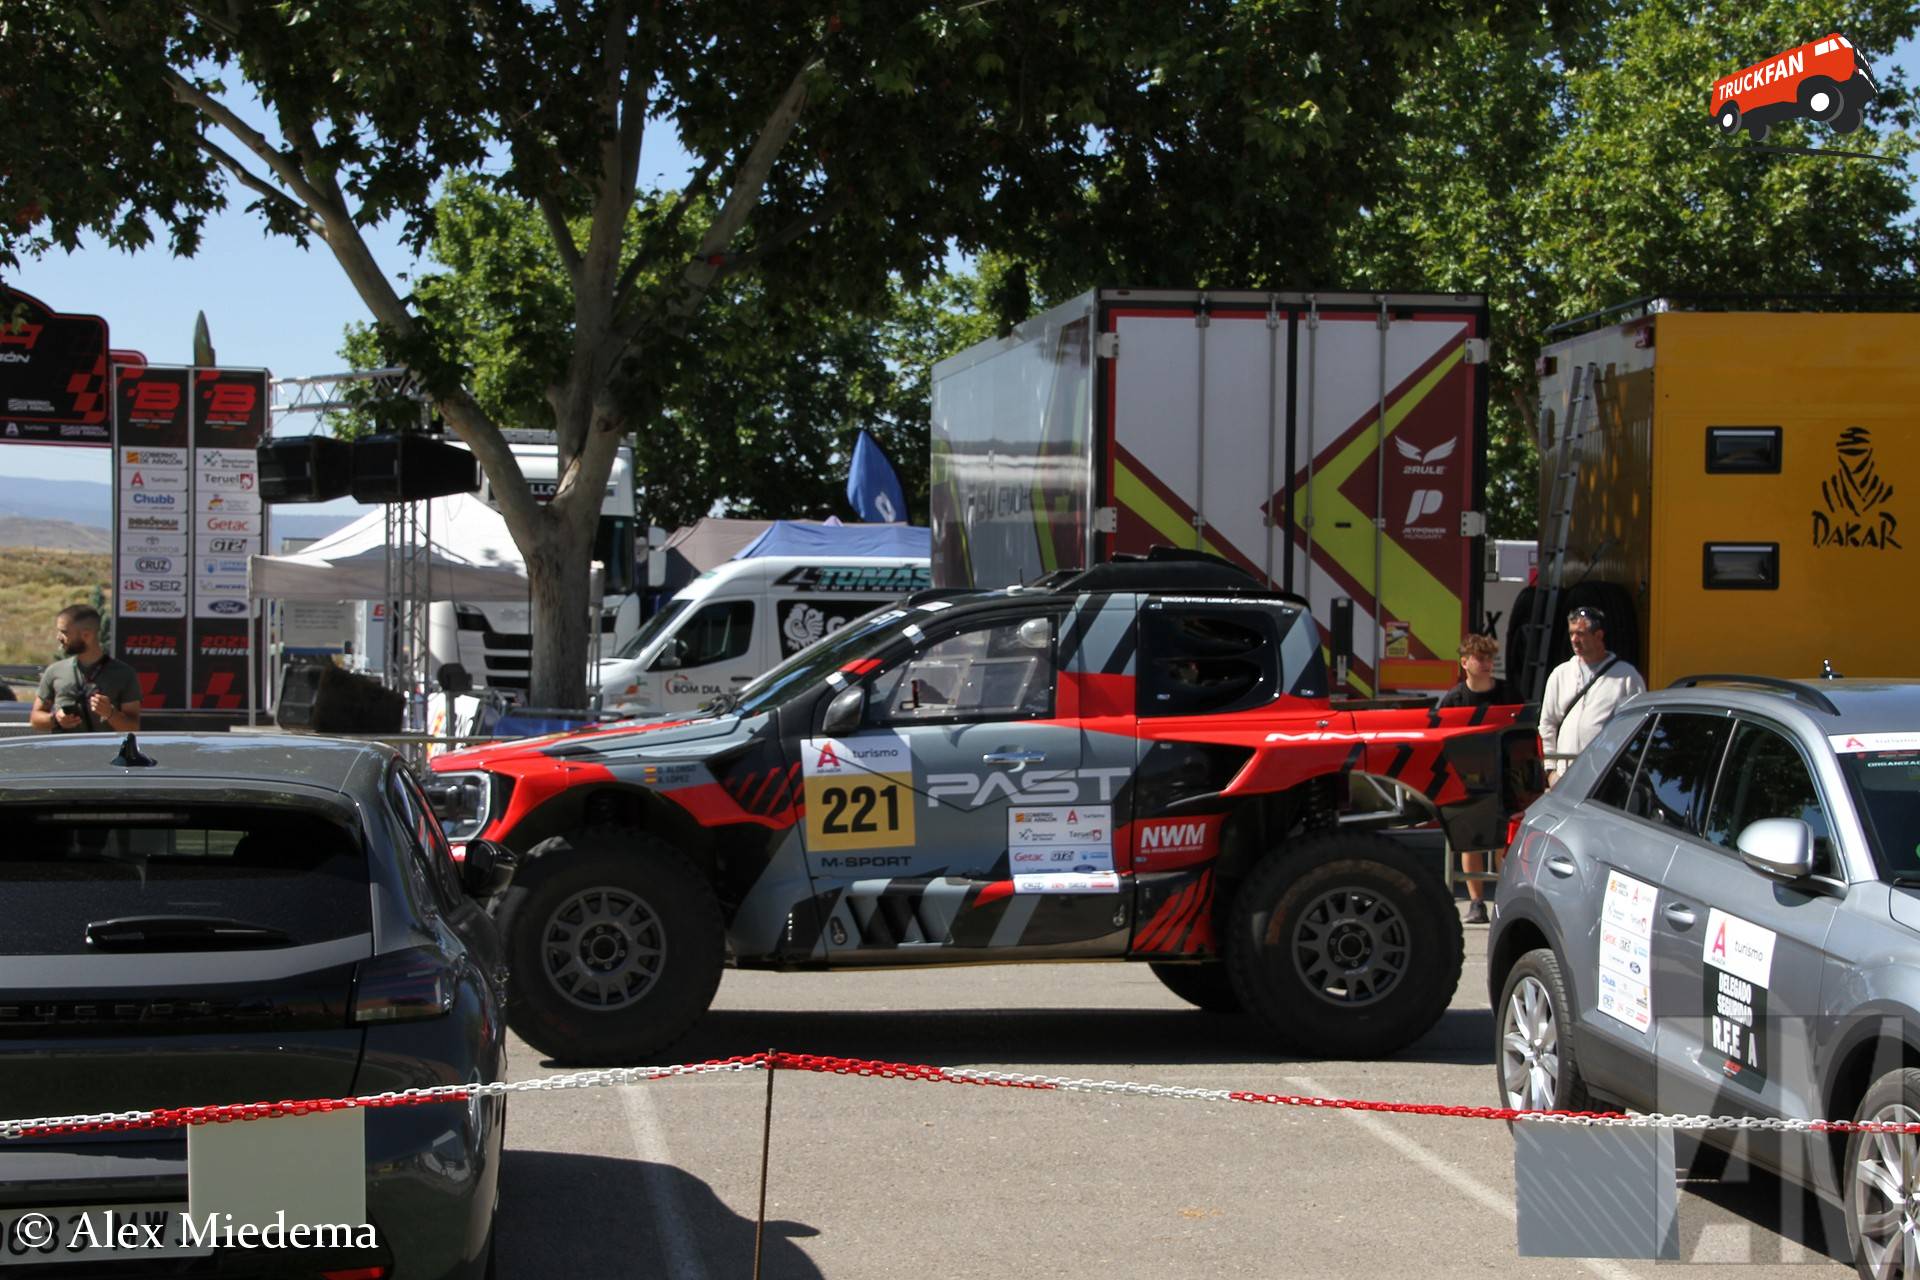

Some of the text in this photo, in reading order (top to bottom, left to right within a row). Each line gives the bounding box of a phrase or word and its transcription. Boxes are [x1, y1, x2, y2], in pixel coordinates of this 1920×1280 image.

[205, 473, 239, 484] Teruel
[133, 494, 175, 504] Chubb
[208, 518, 249, 531] Getac
[1812, 510, 1903, 551] DAKAR
[138, 560, 167, 571] CRUZ
[673, 685, 700, 694] BOM
[702, 685, 722, 694] DIA
[852, 749, 898, 759] turismo
[926, 767, 1132, 808] PAST
[821, 784, 900, 835] 221
[1141, 823, 1207, 849] NWM
[820, 856, 912, 868] M-SPORT
[1734, 940, 1764, 962] turismo
[1718, 971, 1753, 1005] DELEGADO
